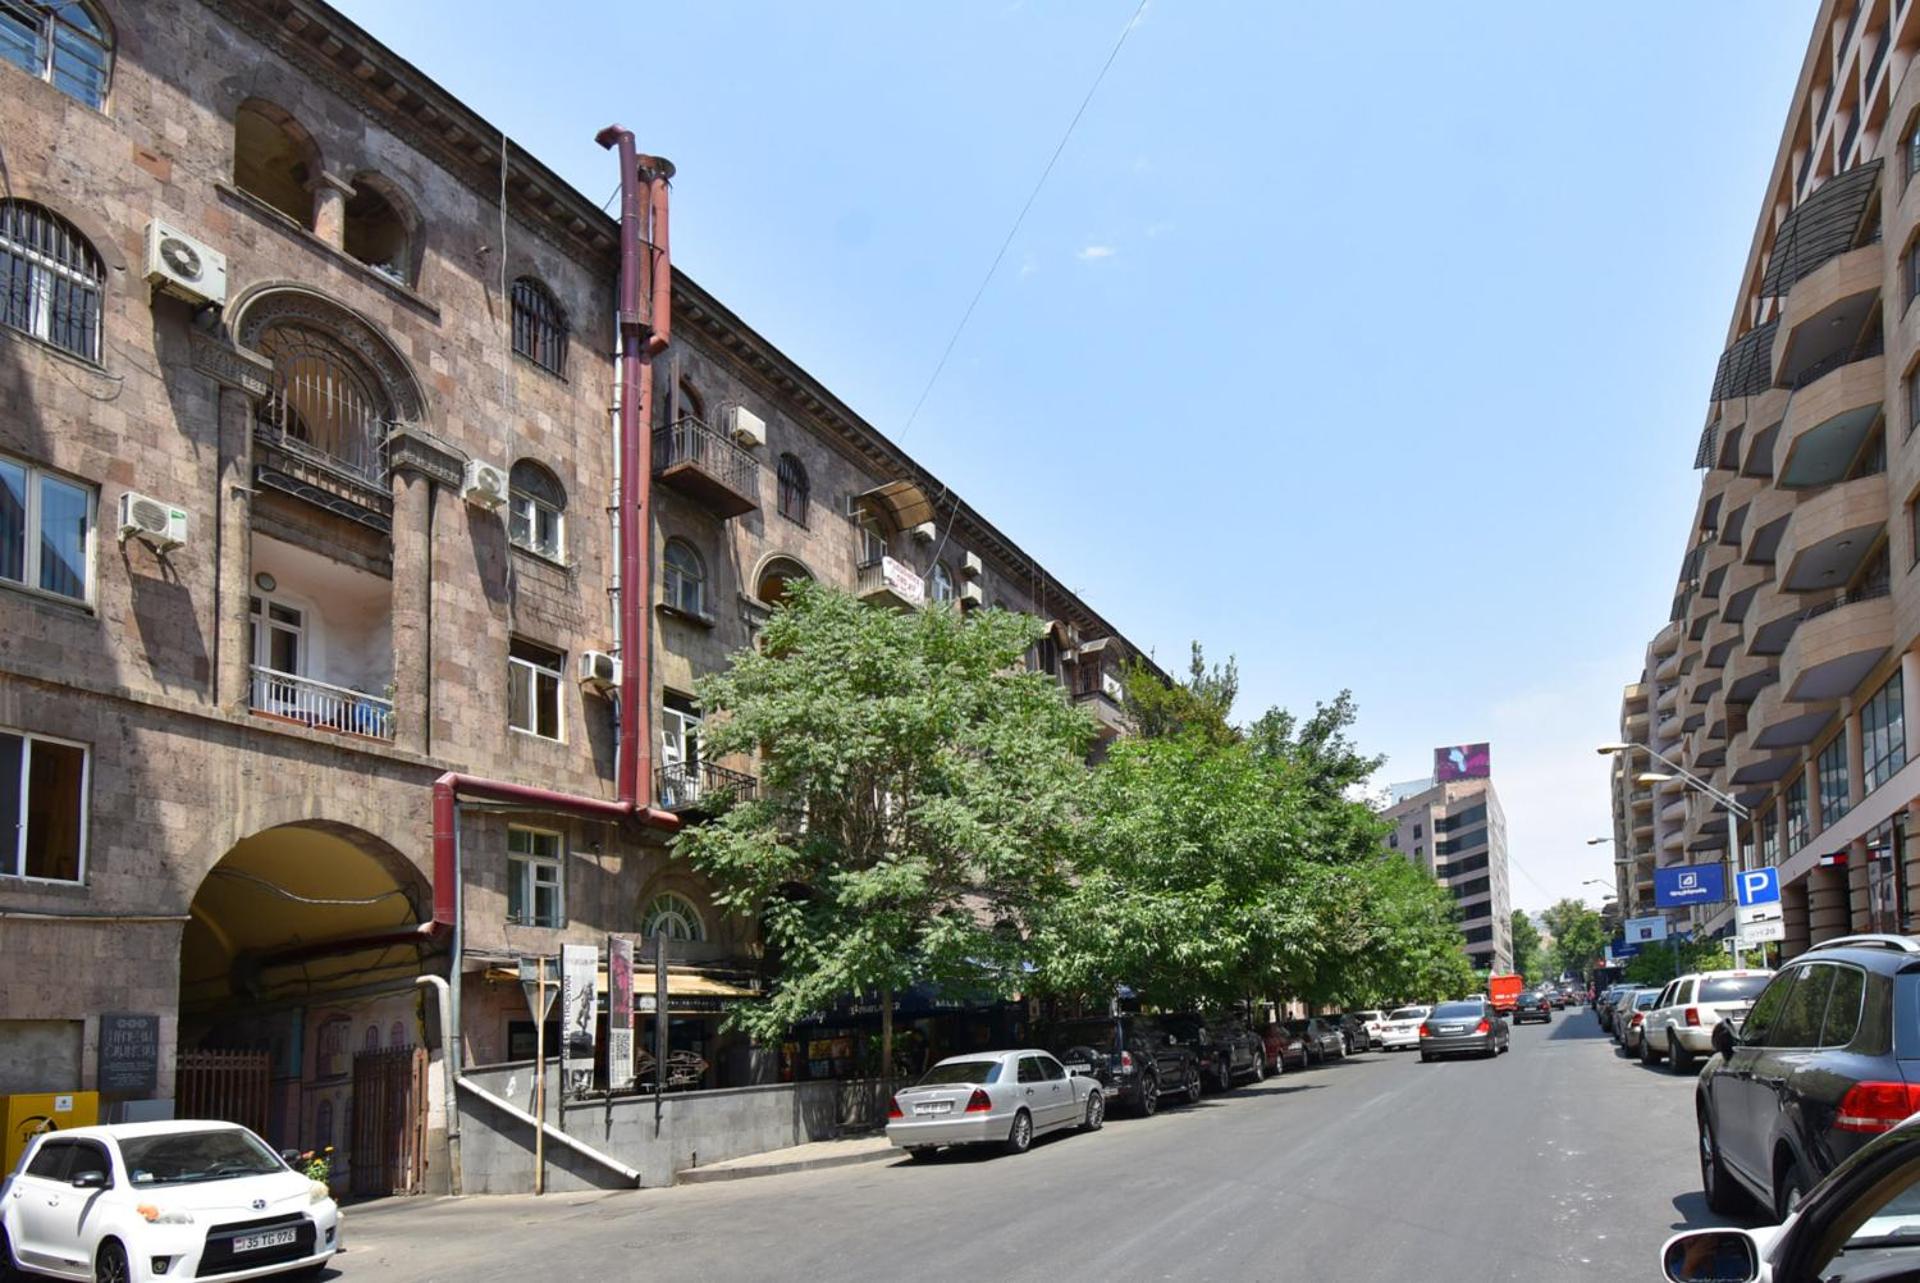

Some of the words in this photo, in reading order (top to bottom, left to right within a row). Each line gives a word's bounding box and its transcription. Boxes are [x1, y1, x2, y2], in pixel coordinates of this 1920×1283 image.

[1744, 872, 1769, 903] P
[563, 975, 572, 1031] PETROSYAN
[246, 1236, 259, 1249] 35
[262, 1232, 275, 1245] TG
